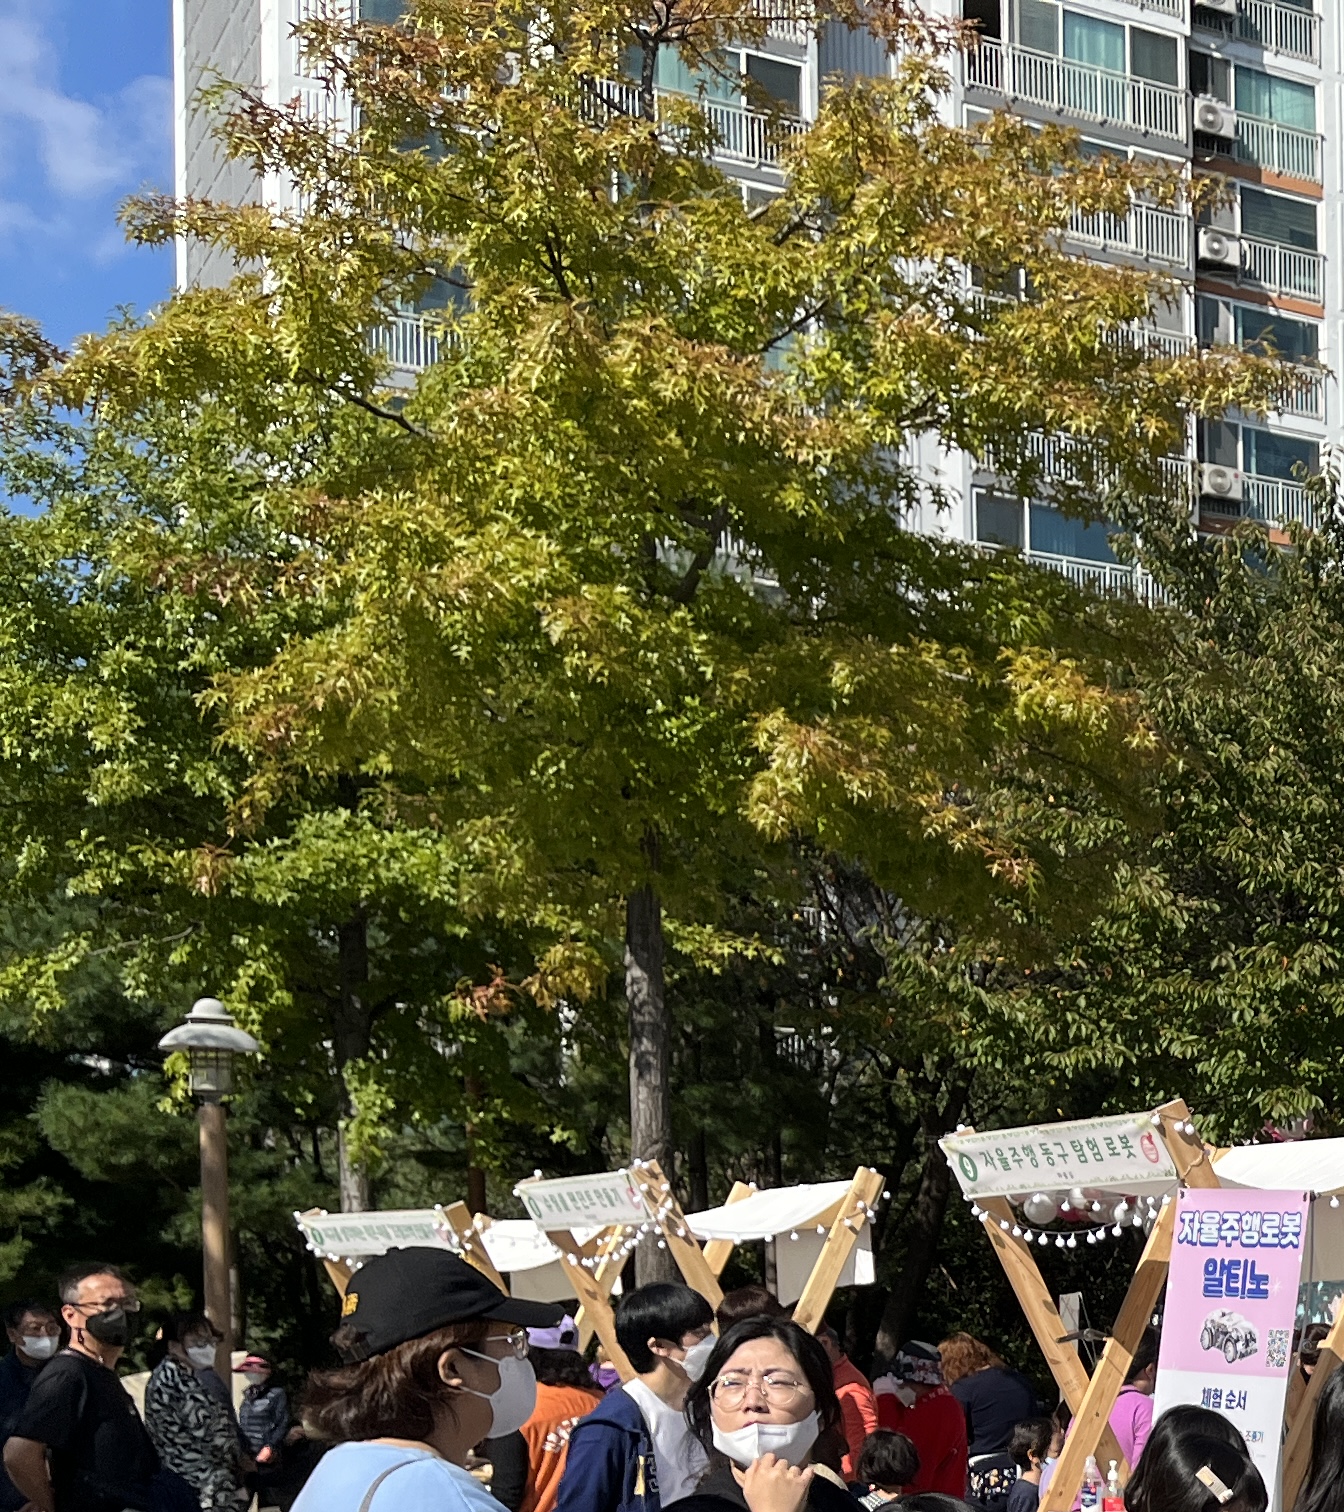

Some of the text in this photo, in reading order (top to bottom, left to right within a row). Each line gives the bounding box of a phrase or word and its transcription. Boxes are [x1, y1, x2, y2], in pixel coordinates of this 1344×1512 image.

[962, 1156, 974, 1179] 9
[979, 1133, 1137, 1172] 자율주행 동구 탐험 로봇
[1178, 1210, 1303, 1249] 자율주행로봇
[1202, 1257, 1270, 1299] 알티노
[1225, 1389, 1248, 1411] 순서
